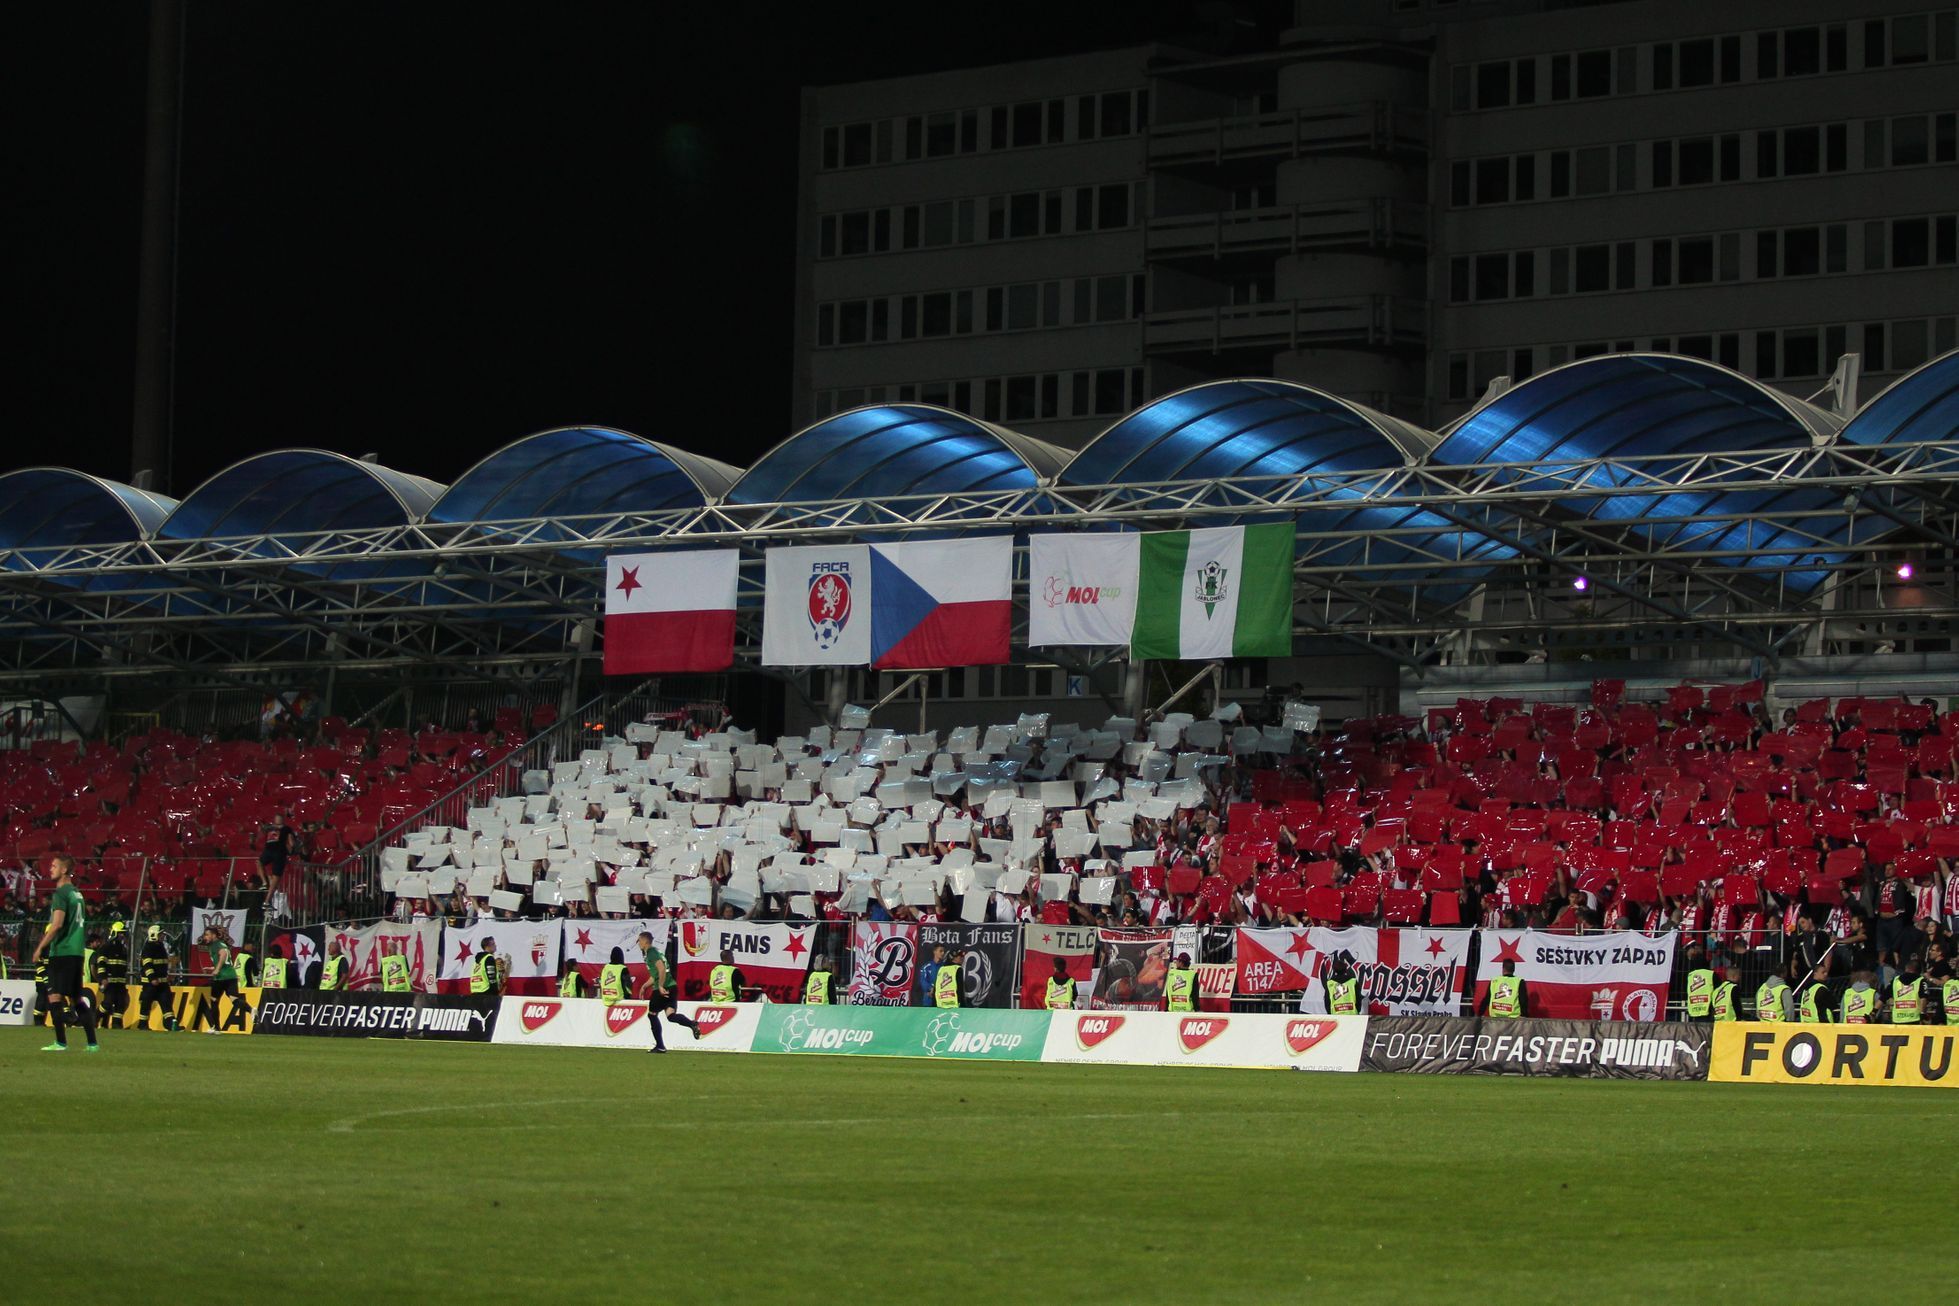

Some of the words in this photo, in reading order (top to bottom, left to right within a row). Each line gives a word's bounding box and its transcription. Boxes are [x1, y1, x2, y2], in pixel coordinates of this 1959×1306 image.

[1065, 586, 1100, 604] MOL
[720, 932, 771, 954] FANS
[922, 927, 960, 946] Beta
[965, 927, 1014, 946] Fans
[1056, 929, 1095, 949] TELČ
[1536, 946, 1606, 965] SEŠÍVKY
[1612, 945, 1666, 966] ZÁPAD
[1245, 961, 1283, 977] AREA
[0, 991, 24, 1014] ze
[525, 1005, 549, 1018] MOL
[417, 1007, 472, 1031] PUMA
[609, 1007, 633, 1020] MOL
[698, 1010, 723, 1023] MOL
[1081, 1019, 1109, 1033] MOL
[1184, 1021, 1213, 1036] MOL
[1290, 1023, 1320, 1038] MOL
[1599, 1038, 1675, 1067] PUMA
[1741, 1031, 1954, 1081] FORTU
